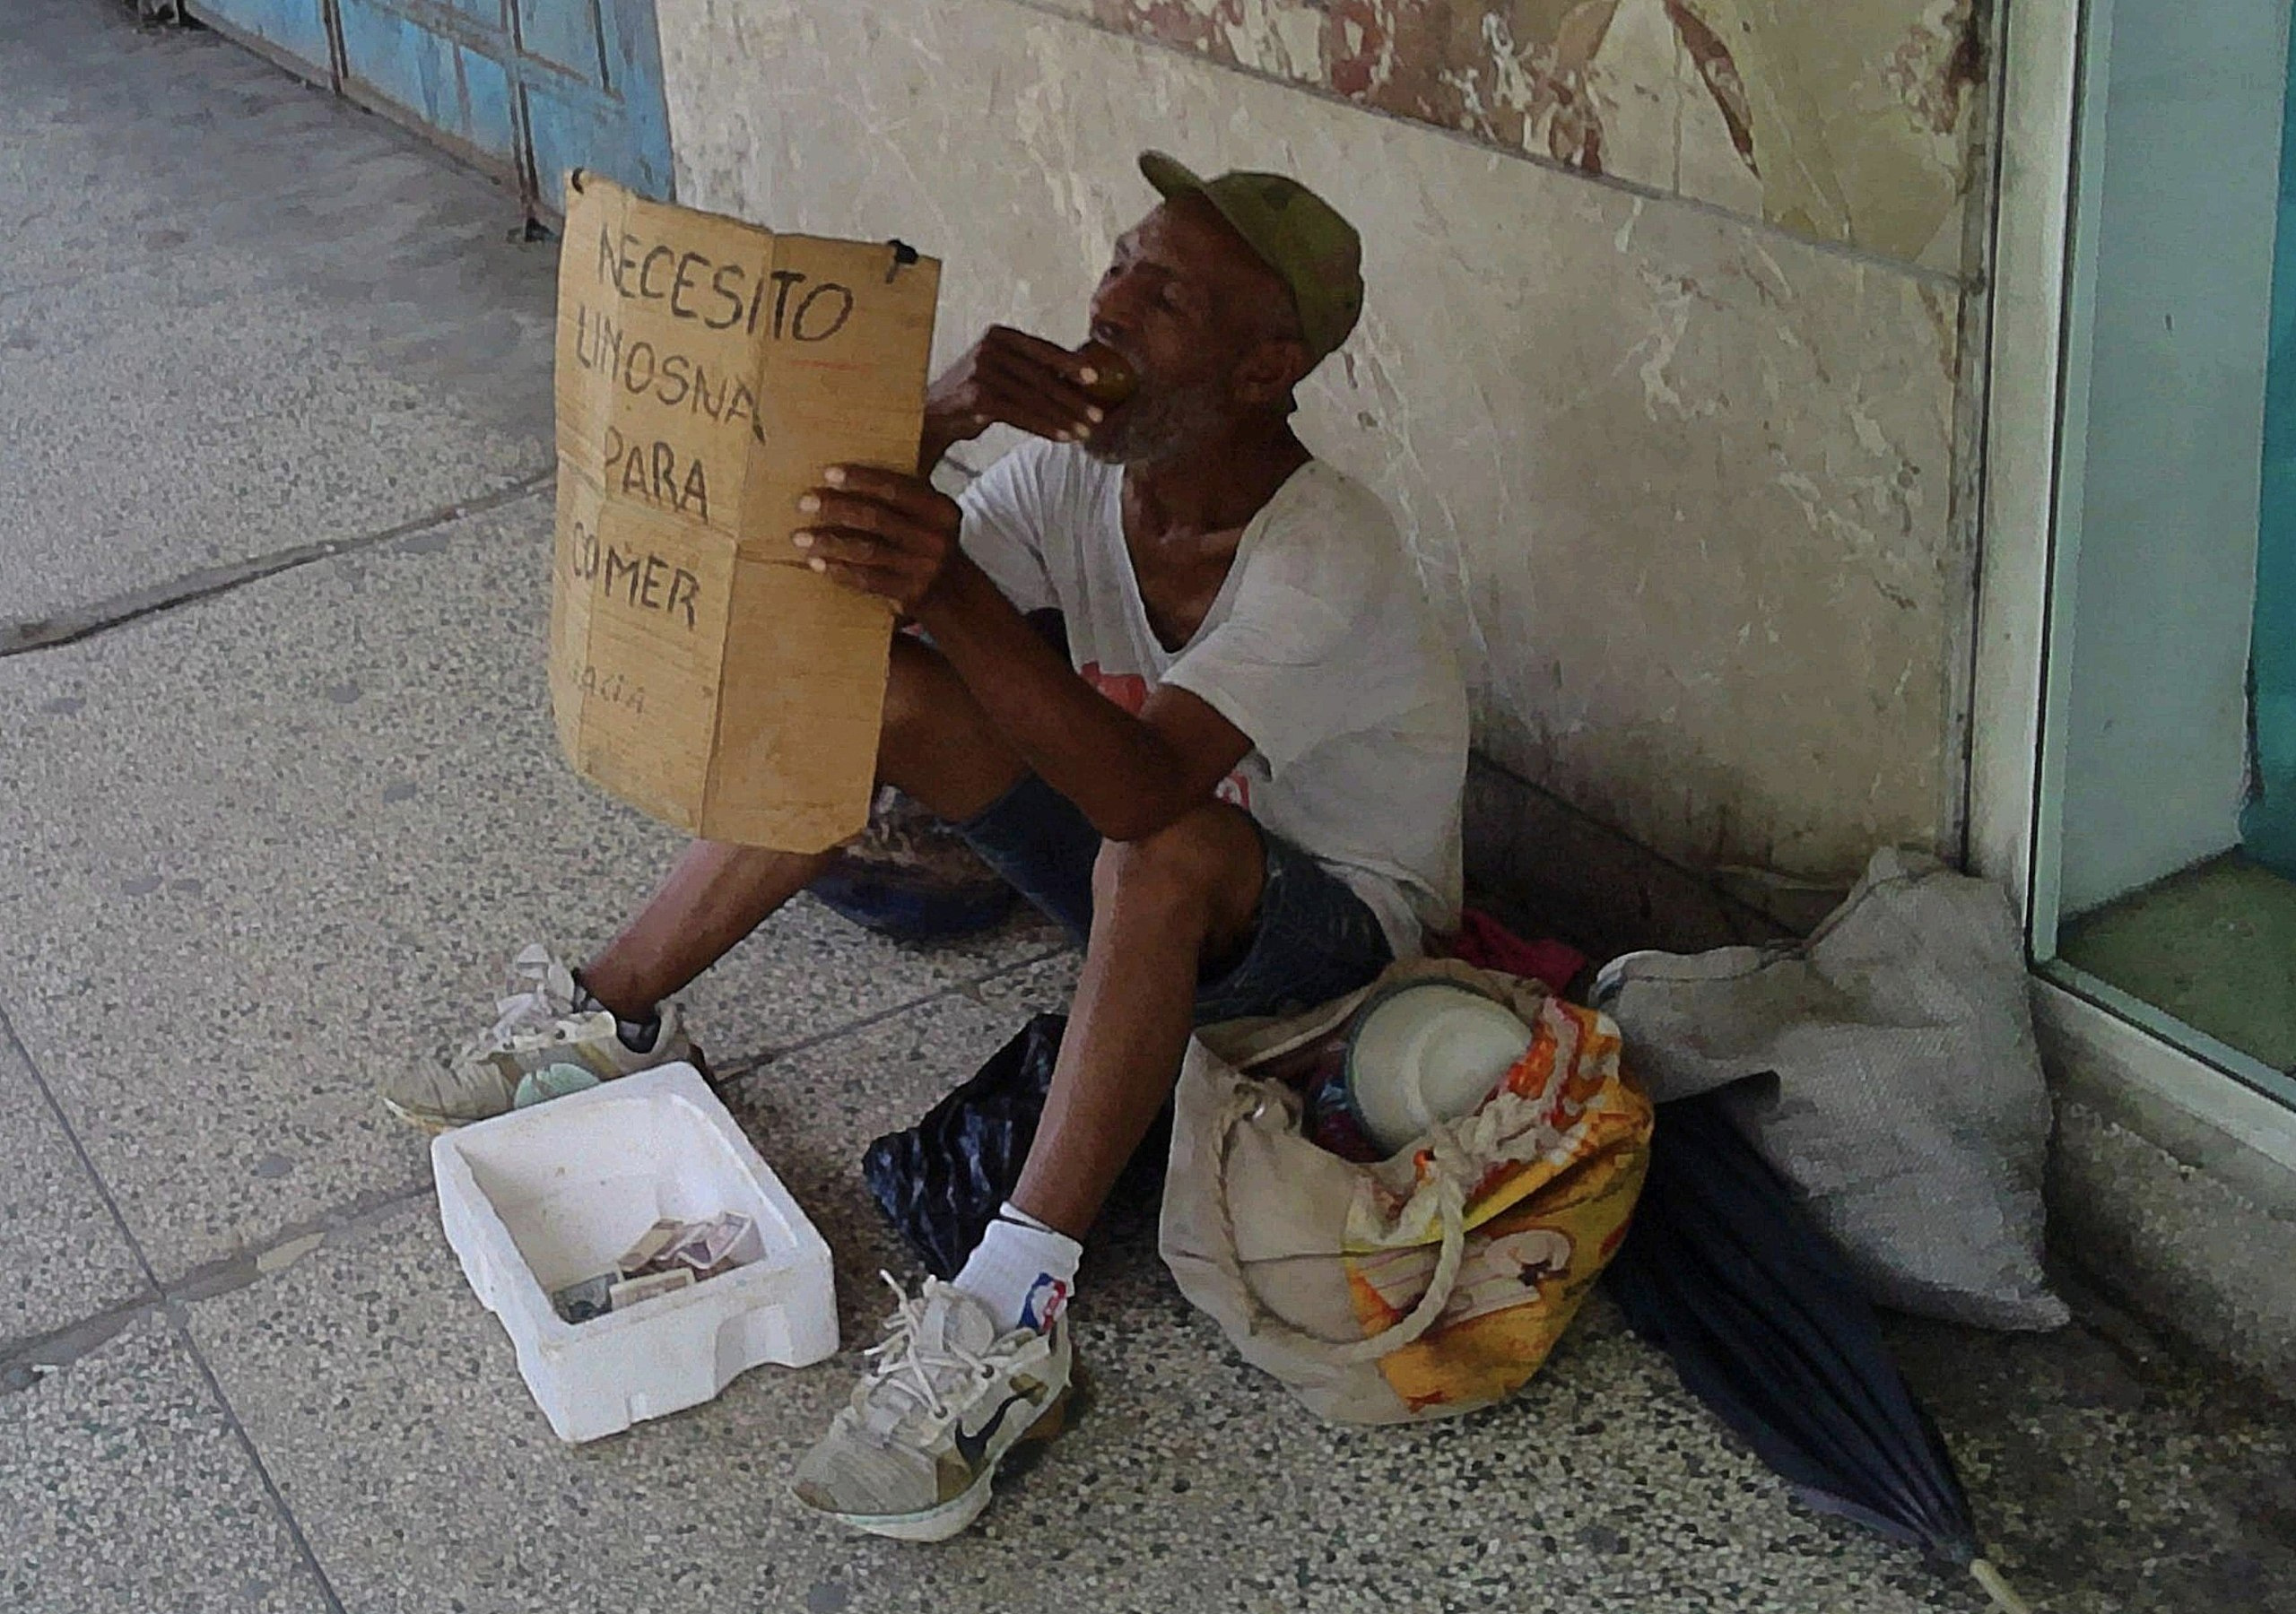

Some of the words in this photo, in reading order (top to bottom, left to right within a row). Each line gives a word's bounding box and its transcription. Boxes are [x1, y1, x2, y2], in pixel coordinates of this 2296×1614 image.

[599, 222, 853, 342] NECESITO
[604, 427, 709, 525] PARA
[571, 522, 700, 629] COMER
